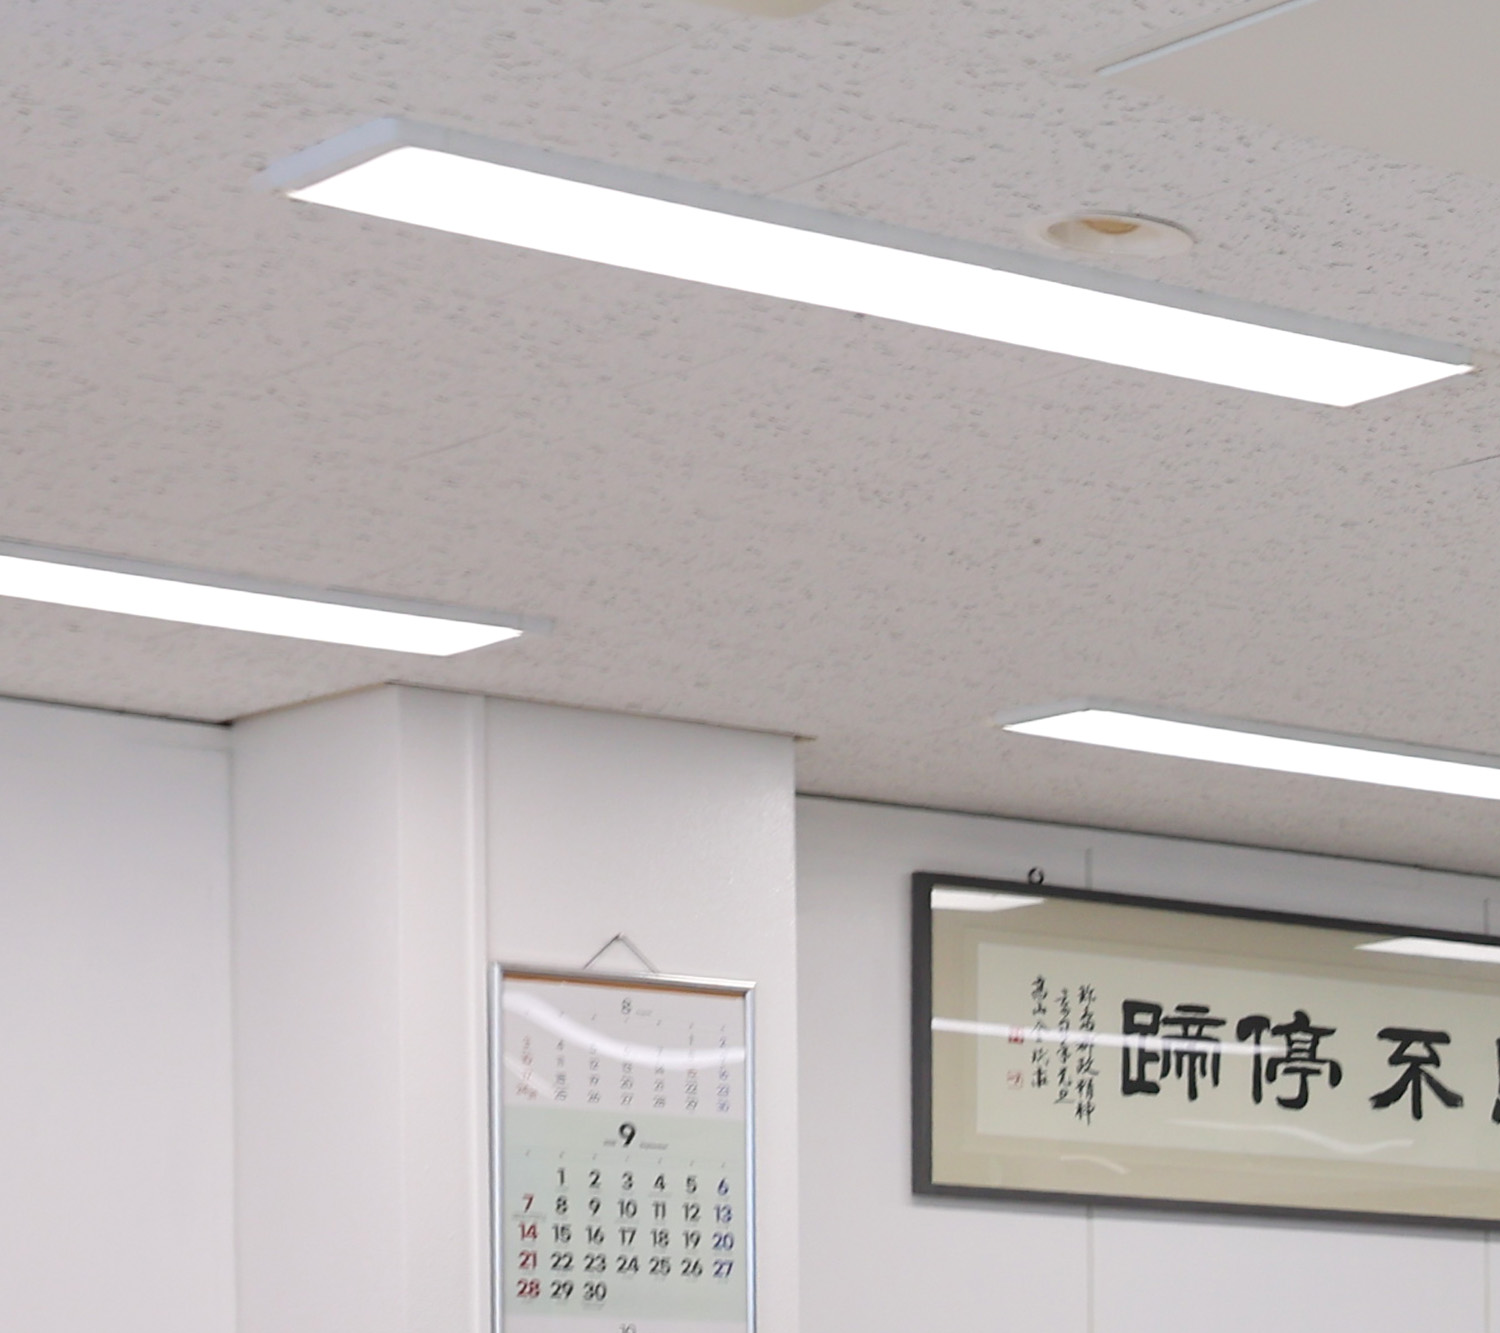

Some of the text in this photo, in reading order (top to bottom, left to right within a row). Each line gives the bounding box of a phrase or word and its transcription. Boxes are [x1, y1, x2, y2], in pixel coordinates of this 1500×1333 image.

[618, 1121, 637, 1148] 9
[557, 1167, 729, 1196] 1 2 3 4 5 6
[522, 1193, 732, 1223] 7 8 9 10 11 12 13
[518, 1222, 734, 1251] 14 15 16 17 18 19 20
[518, 1250, 734, 1278] 21 22 23 24 25 26 27
[516, 1278, 607, 1301] 28 29 30
